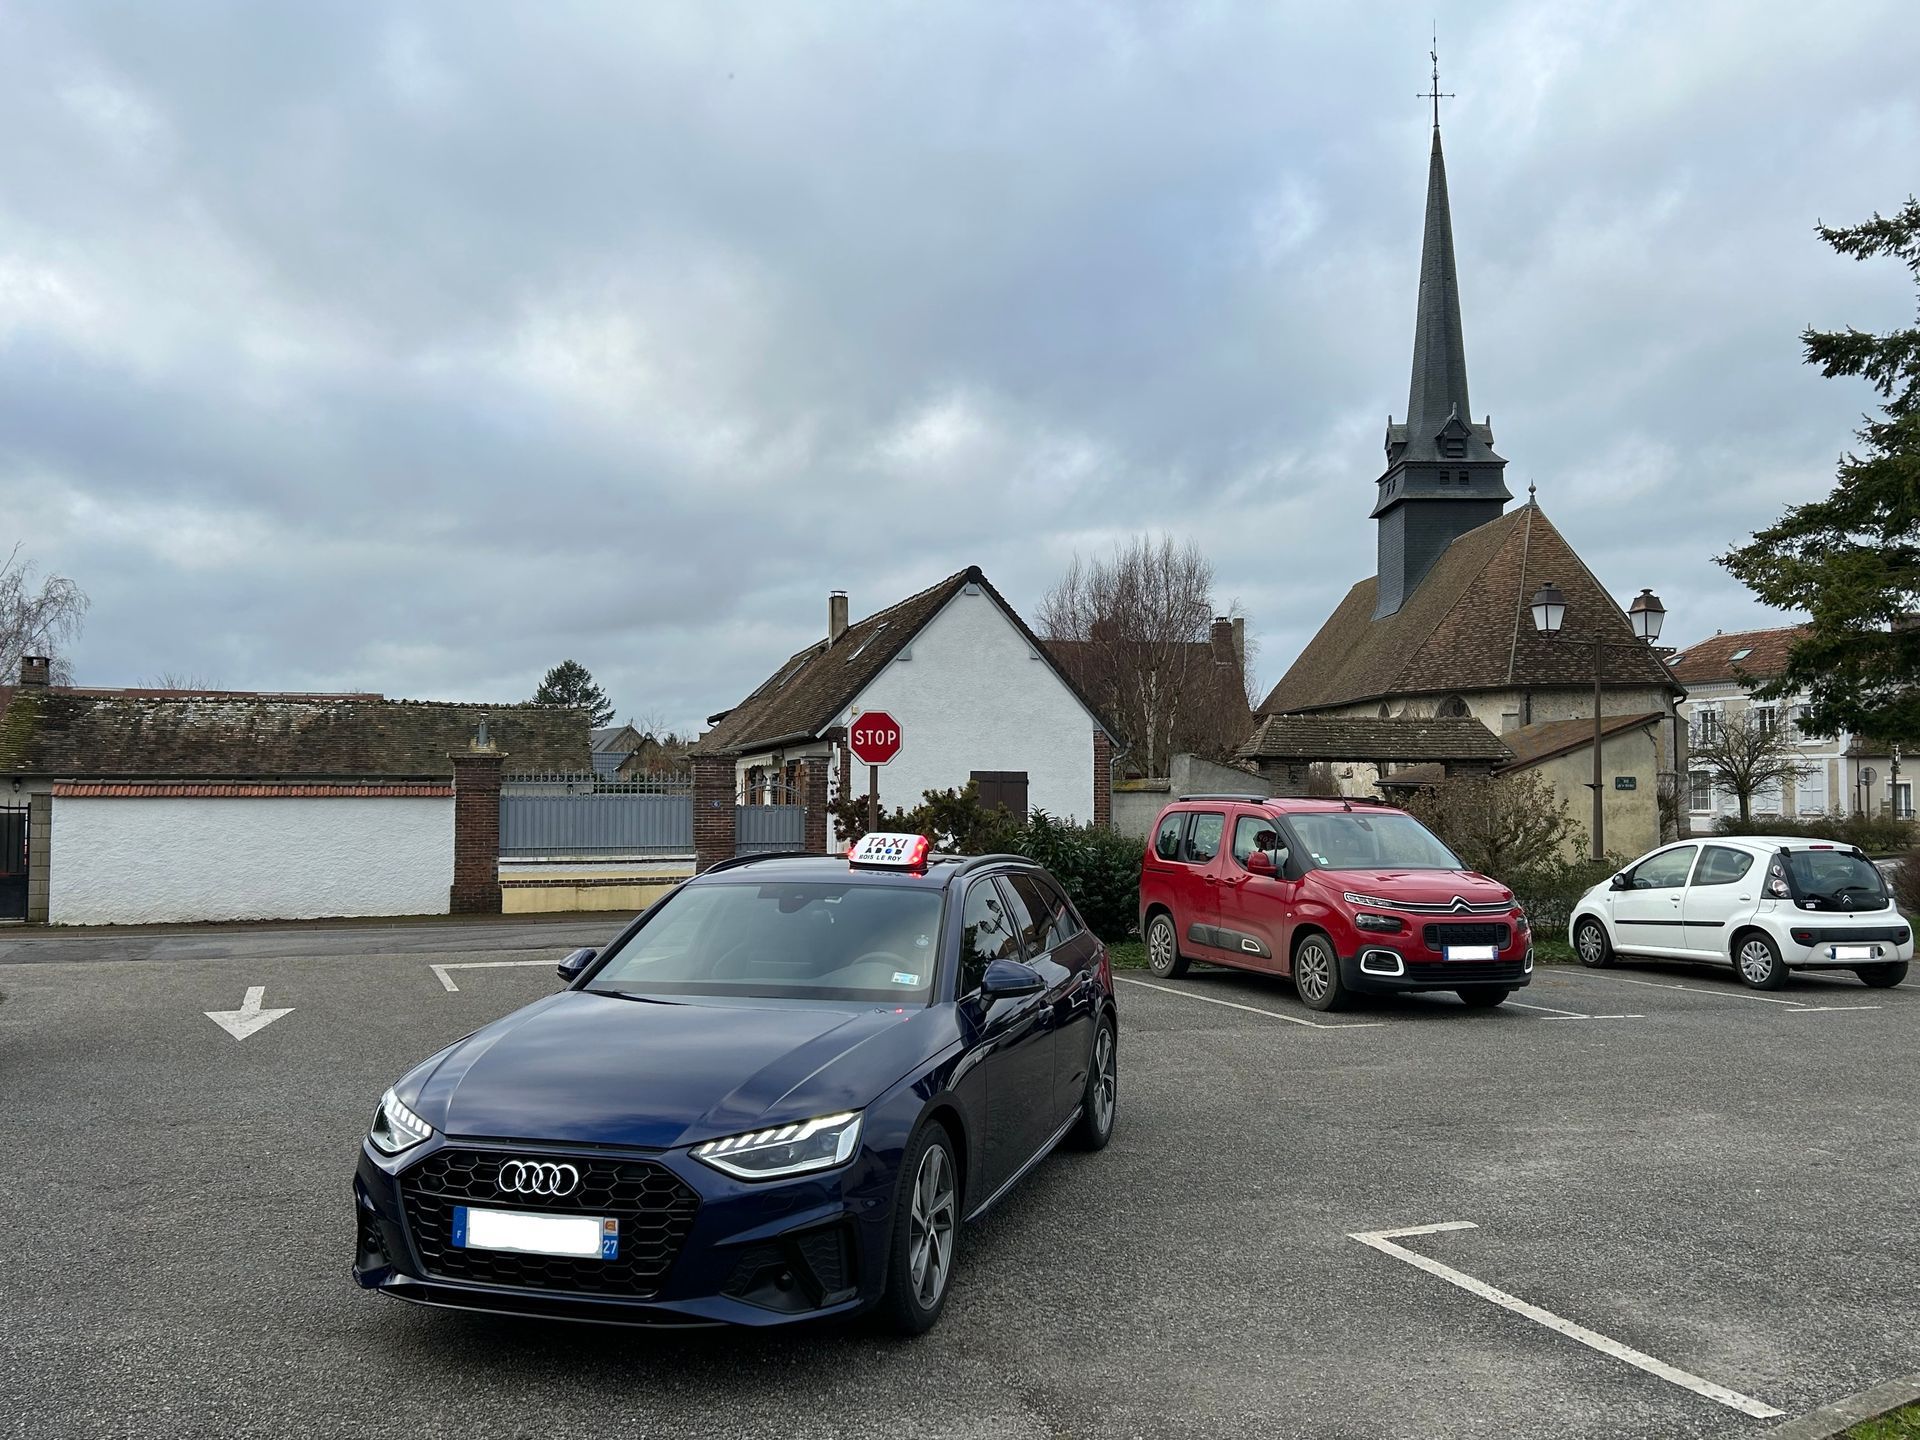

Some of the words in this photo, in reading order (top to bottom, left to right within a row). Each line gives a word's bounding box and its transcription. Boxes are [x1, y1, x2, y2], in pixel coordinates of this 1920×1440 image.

[855, 730, 897, 745] STOP
[868, 837, 908, 849] TAXI
[457, 1230, 462, 1239] F
[603, 1239, 618, 1254] 27
